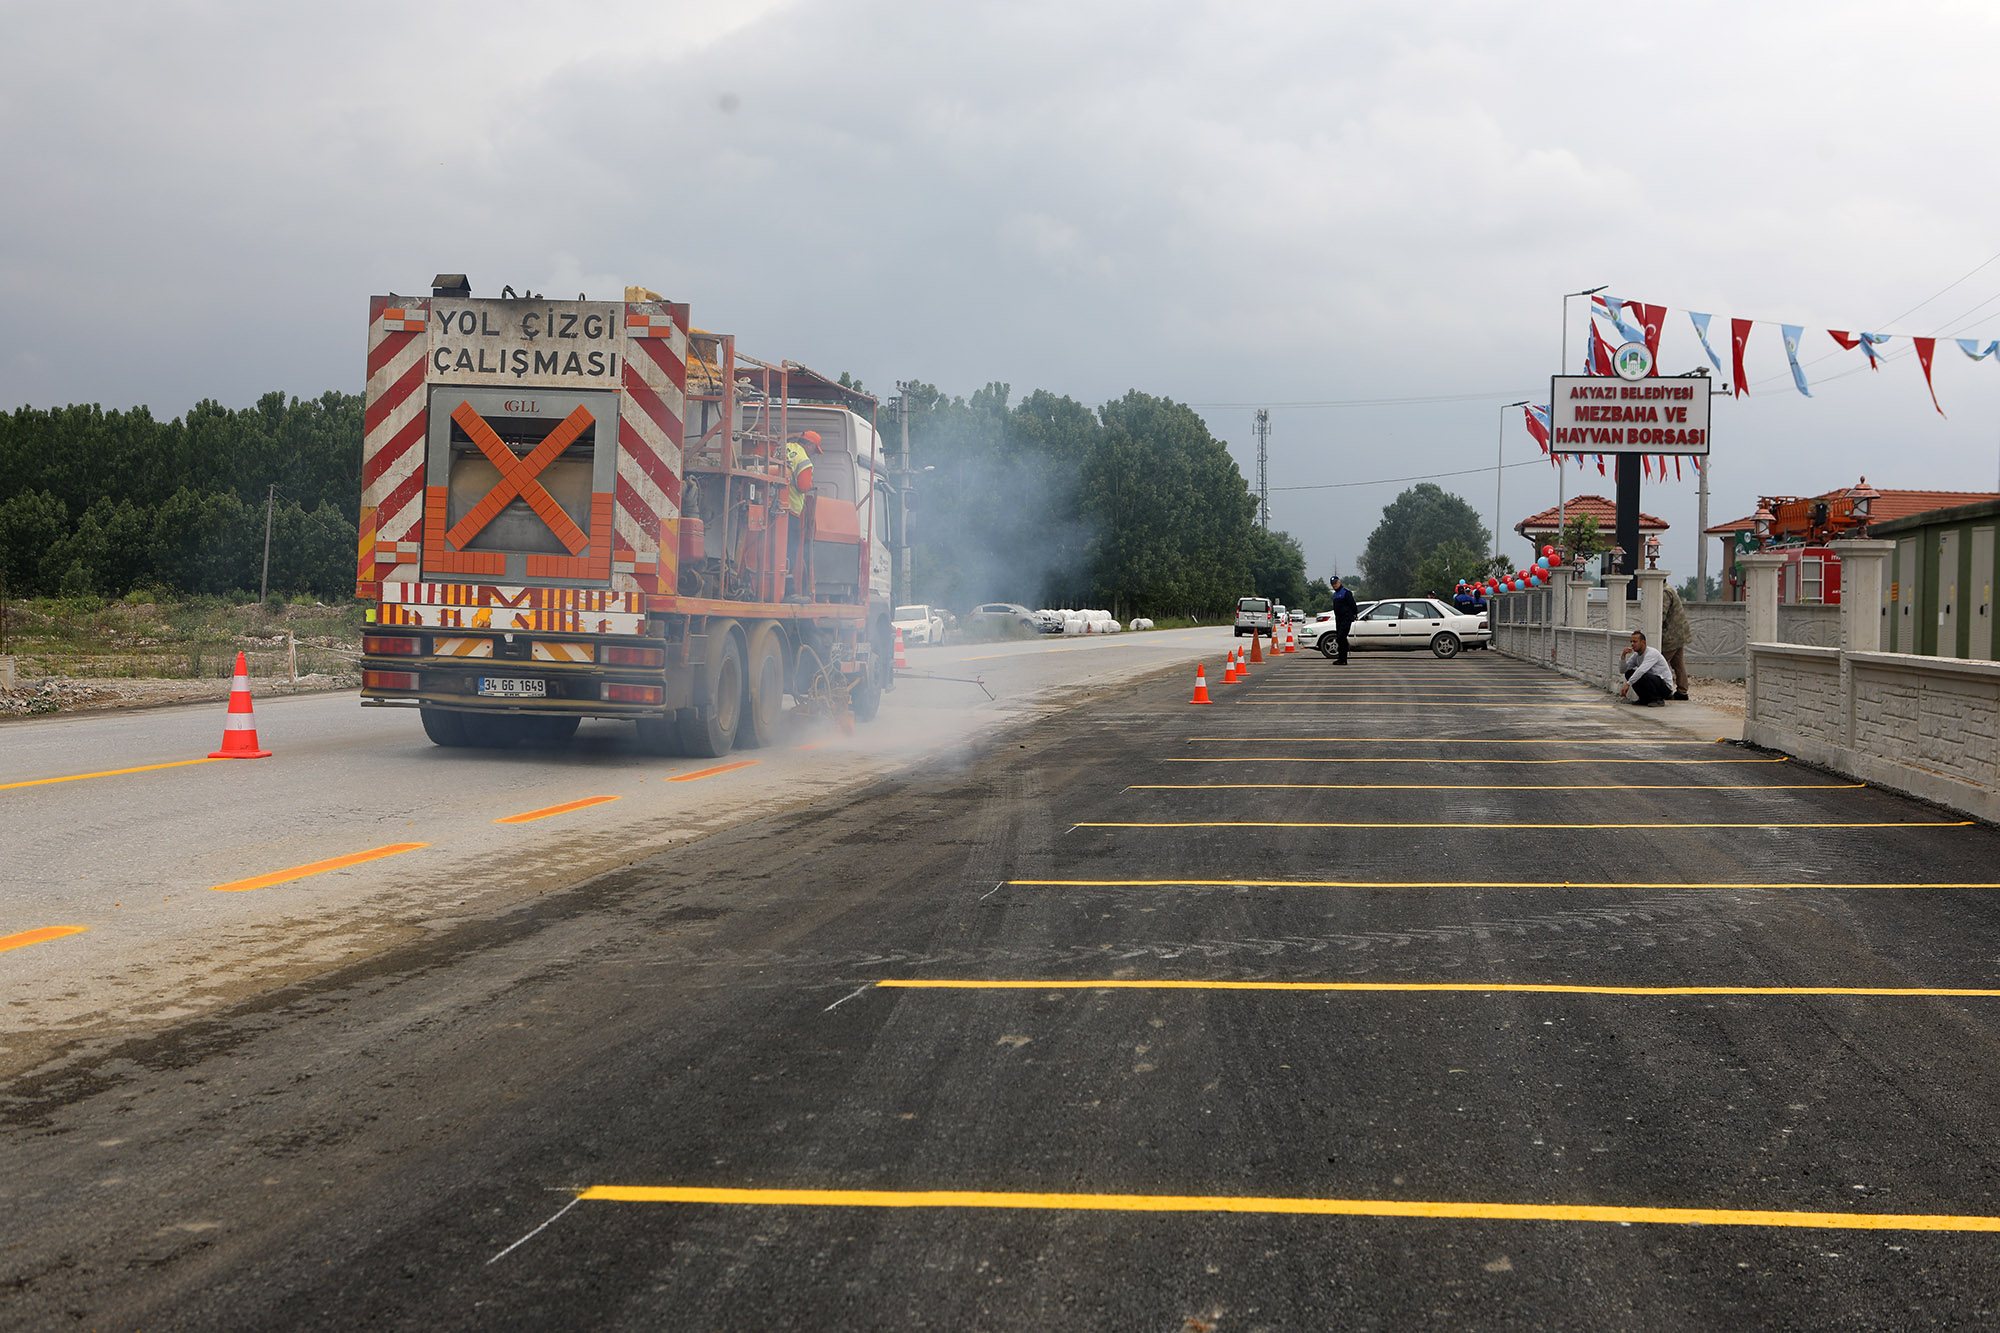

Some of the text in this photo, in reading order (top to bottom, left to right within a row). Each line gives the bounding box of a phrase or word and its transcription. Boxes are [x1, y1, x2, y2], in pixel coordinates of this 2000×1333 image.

[436, 307, 615, 341] YOL ÇİZGİ
[433, 347, 616, 378] ÇALIŞMASI
[1570, 385, 1694, 400] AKYAZI BELEDİYESİ
[1575, 406, 1688, 423] MEZBAHA VE
[1556, 427, 1705, 445] HAYVAN BORSASI
[485, 680, 497, 691] 34
[502, 680, 514, 691] GG
[520, 680, 544, 692] 1649
